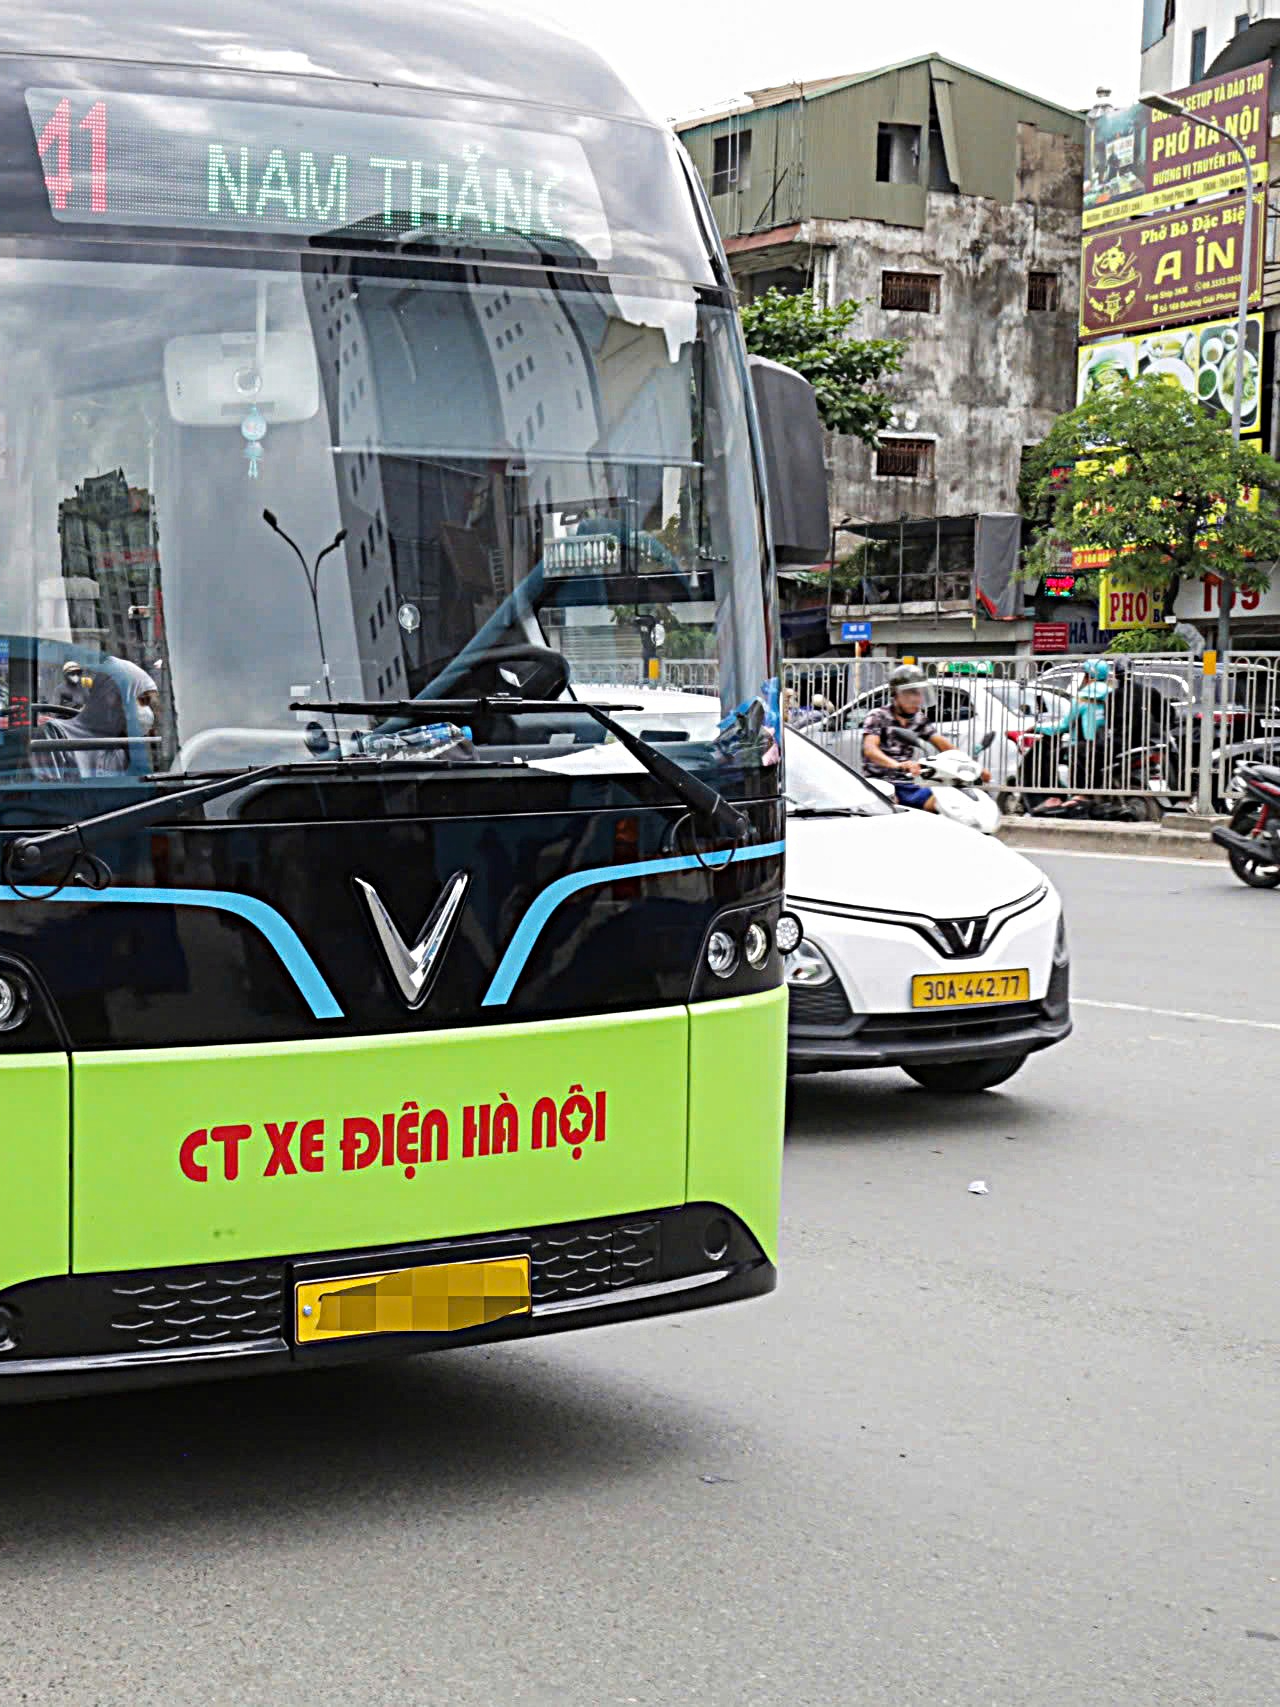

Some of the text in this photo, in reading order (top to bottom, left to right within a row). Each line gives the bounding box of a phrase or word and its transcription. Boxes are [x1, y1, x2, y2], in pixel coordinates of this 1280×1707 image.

[1185, 89, 1213, 112] SETUP
[1214, 83, 1225, 103] VÀ
[1152, 105, 1260, 161] PHỞ HÀ NỘI
[208, 143, 347, 222] NAM
[1140, 206, 1245, 246] Phở Bò Đặc Biệ
[1153, 250, 1182, 285] A
[923, 976, 1020, 1001] 30A-442.77
[179, 1083, 607, 1182] CT XE ĐIỆN HÀ NỘI
